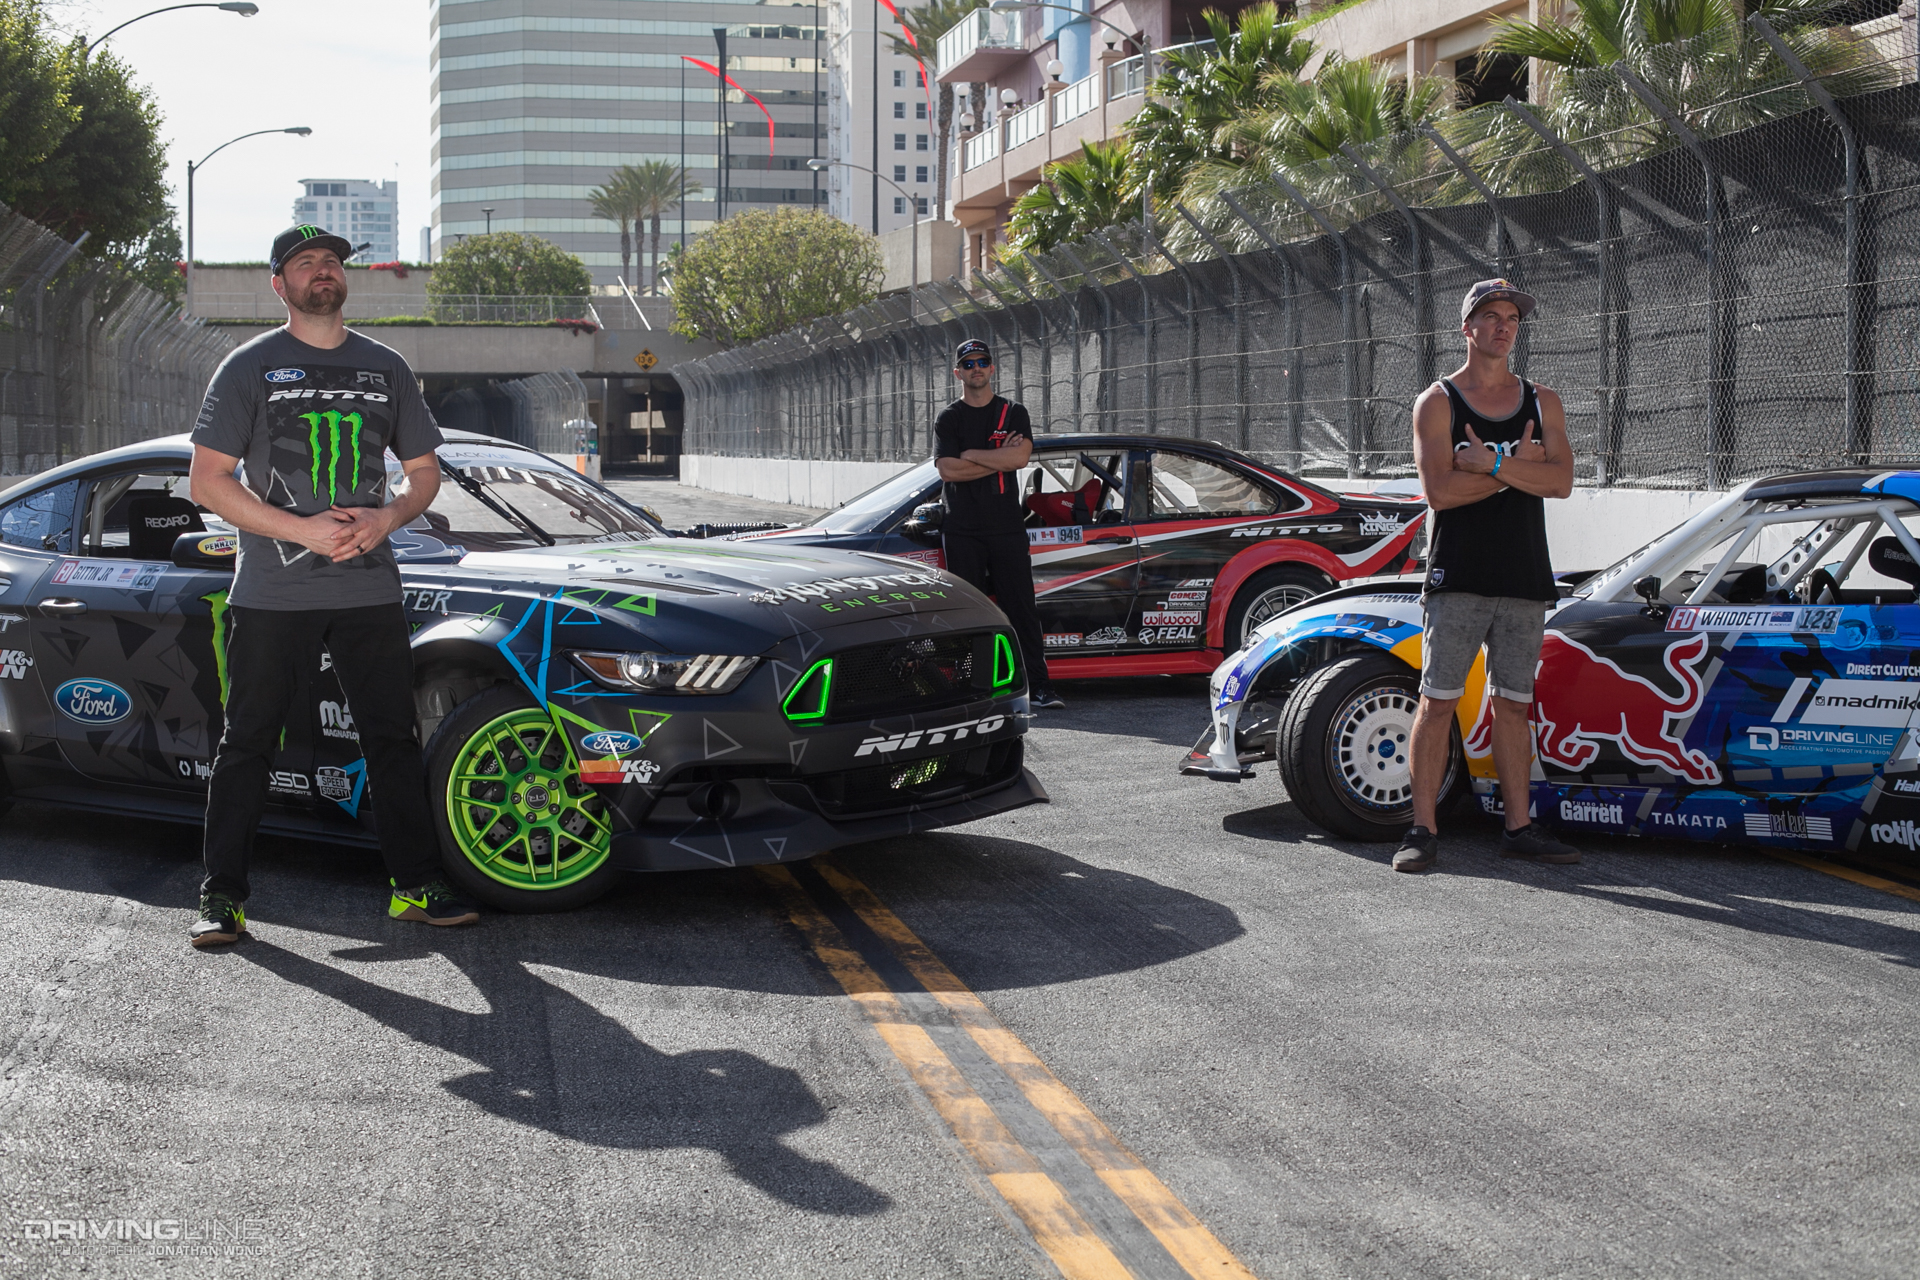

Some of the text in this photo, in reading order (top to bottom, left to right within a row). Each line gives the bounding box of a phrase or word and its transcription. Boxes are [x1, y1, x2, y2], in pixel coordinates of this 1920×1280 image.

[273, 371, 298, 381] Ford
[267, 389, 389, 402] NITTO
[145, 514, 190, 528] RECARO
[1060, 528, 1080, 541] 949
[1230, 523, 1344, 538] NITTO
[1360, 522, 1405, 536] KINGS
[72, 566, 100, 581] GITTIN
[99, 567, 114, 581] JR
[766, 573, 953, 605] MONSTER
[1184, 578, 1214, 587] ACT
[820, 589, 948, 613] ENERGY
[1143, 611, 1201, 626] wilwood
[1671, 608, 1837, 630] FD WHIDDETT 123
[1046, 634, 1080, 645] RHS
[1156, 626, 1196, 640] FEAL
[1846, 663, 1882, 676] DIRECT
[70, 684, 118, 717] Ford
[593, 734, 631, 751] Ford
[854, 714, 1005, 757] NITTO
[1826, 747, 1864, 755] AUTOMOTIVE
[195, 760, 211, 780] hpi
[321, 776, 345, 788] SPEED
[321, 786, 349, 799] SOCIETY
[1560, 800, 1624, 825] Garrett
[1651, 811, 1728, 829] TAKATA
